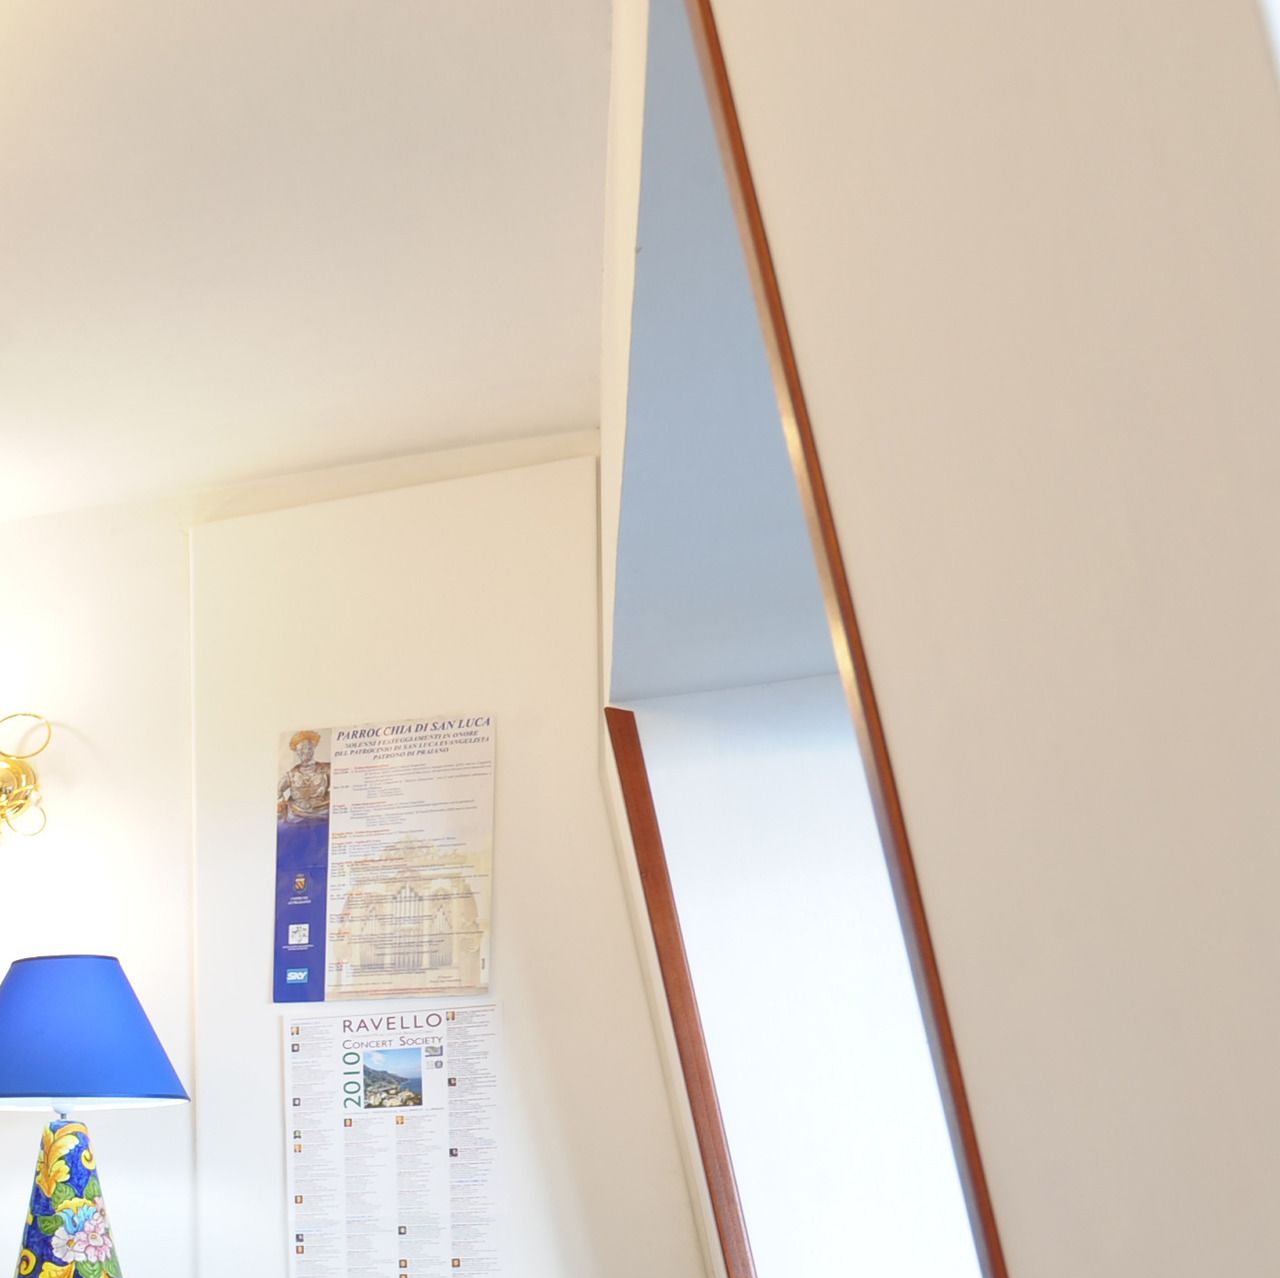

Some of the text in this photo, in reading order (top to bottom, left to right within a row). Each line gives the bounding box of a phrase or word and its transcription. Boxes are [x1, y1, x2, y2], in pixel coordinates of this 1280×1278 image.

[336, 717, 491, 741] PARROCCHIA DI SAN LUCA
[342, 1013, 442, 1033] RAVELLO
[342, 1051, 362, 1109] 2010
